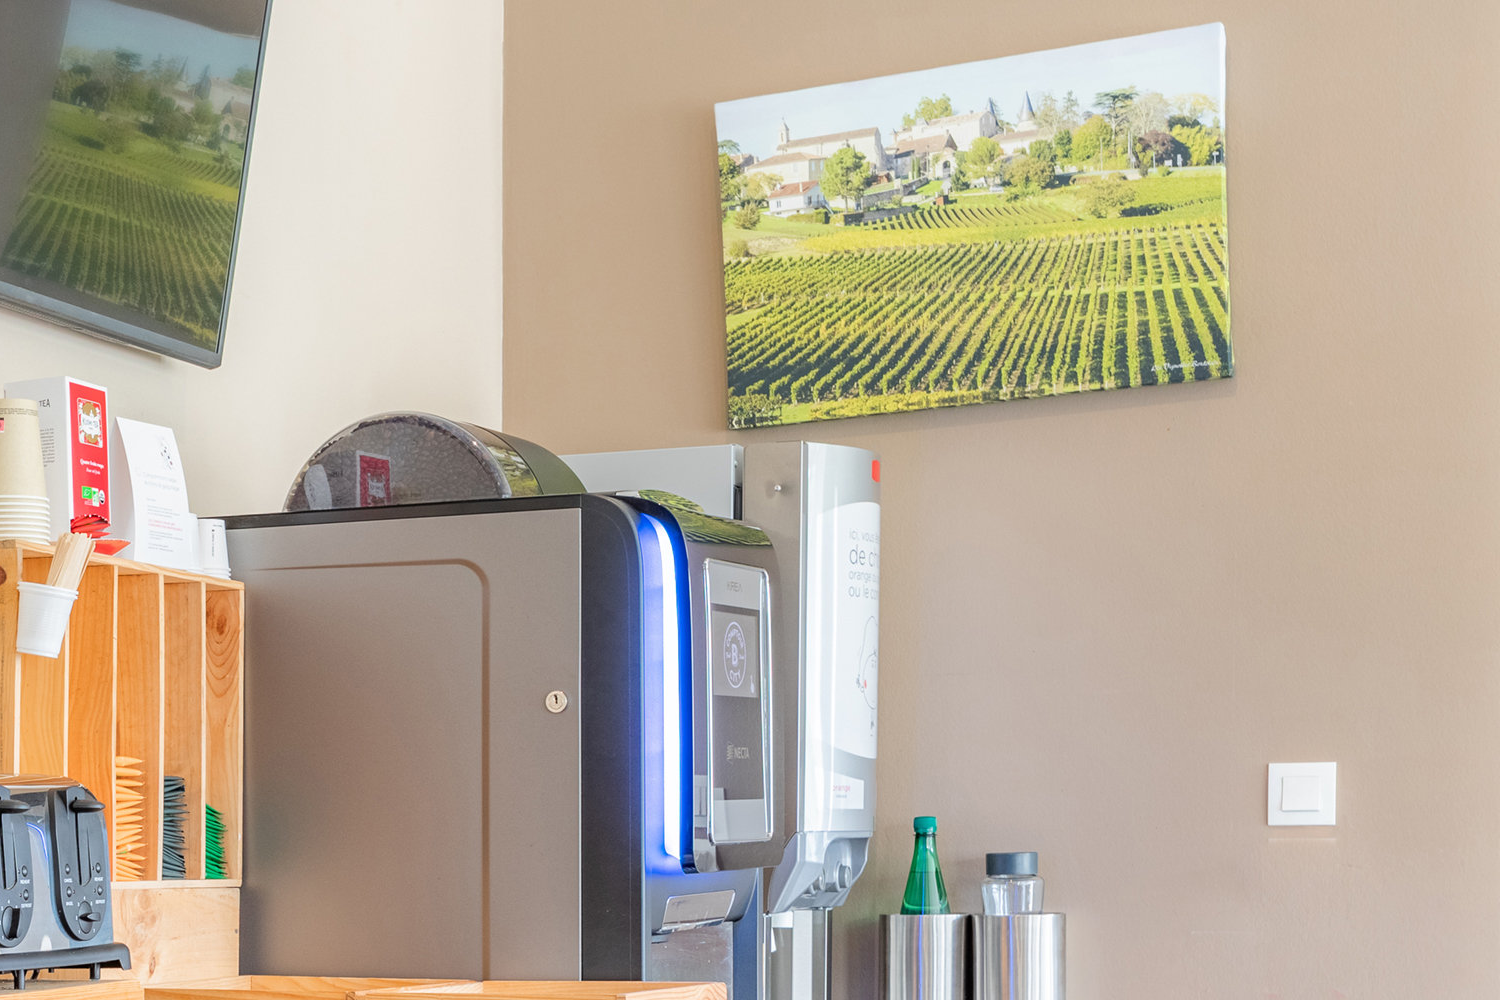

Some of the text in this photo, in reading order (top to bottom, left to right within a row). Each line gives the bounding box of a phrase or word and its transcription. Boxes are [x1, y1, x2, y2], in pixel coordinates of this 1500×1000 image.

[38, 399, 51, 408] TEA
[849, 543, 866, 566] de
[848, 586, 861, 598] ou
[731, 643, 739, 667] B
[734, 746, 750, 760] NECTA
